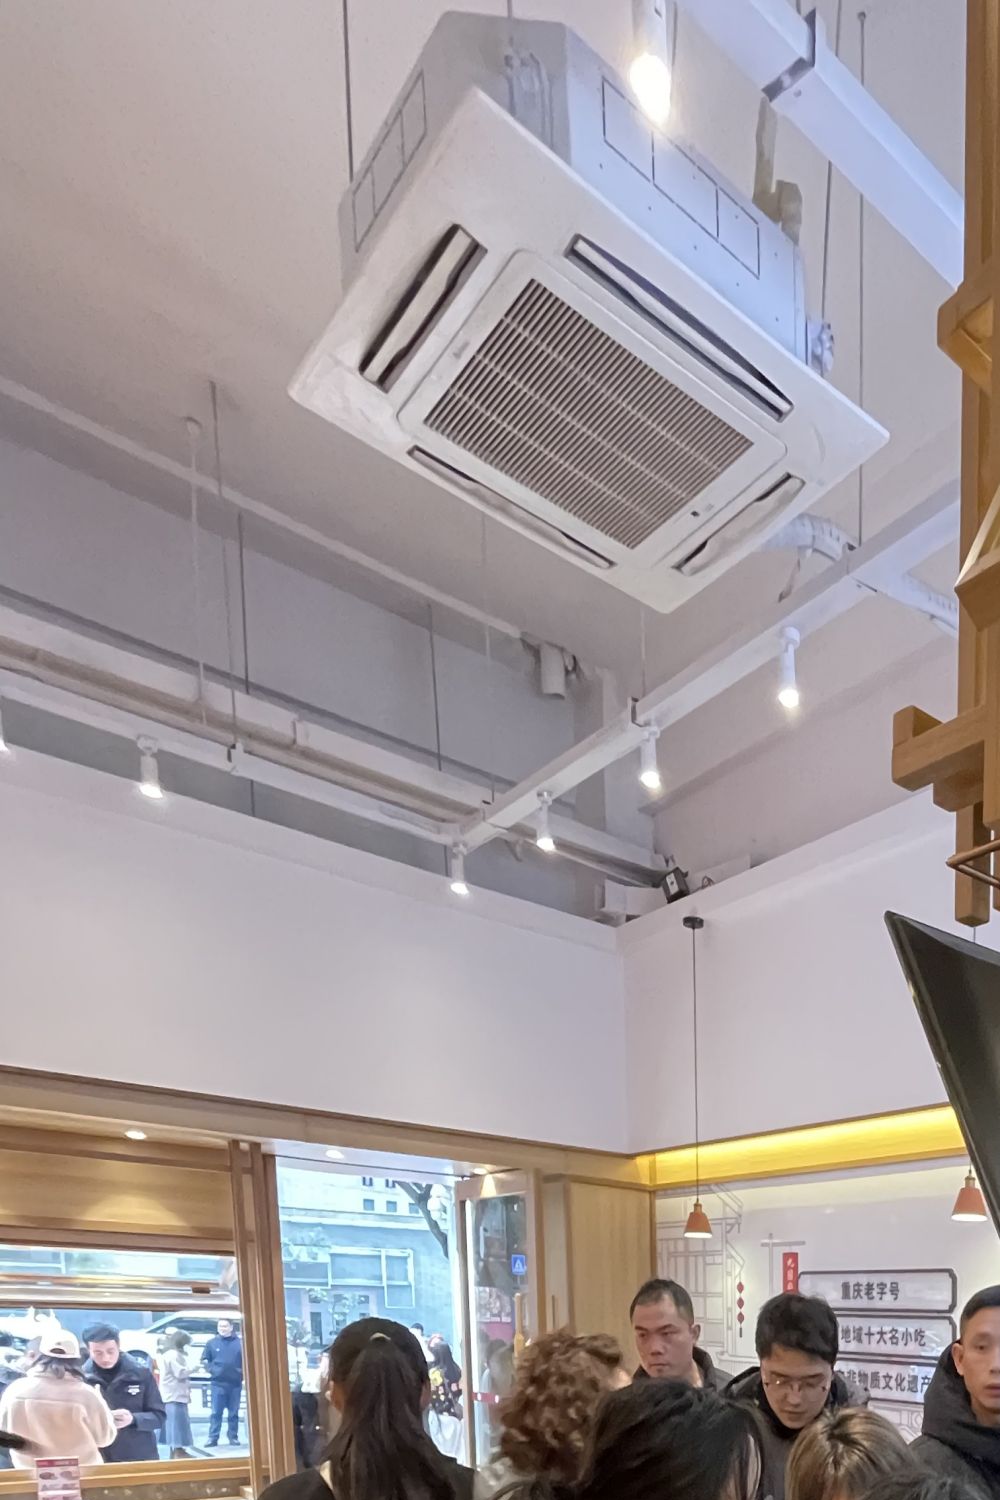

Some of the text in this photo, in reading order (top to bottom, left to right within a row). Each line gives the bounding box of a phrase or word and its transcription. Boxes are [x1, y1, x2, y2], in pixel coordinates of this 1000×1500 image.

[841, 1281, 900, 1301] 重庆老字号
[840, 1325, 926, 1347] 地域十大名小吃
